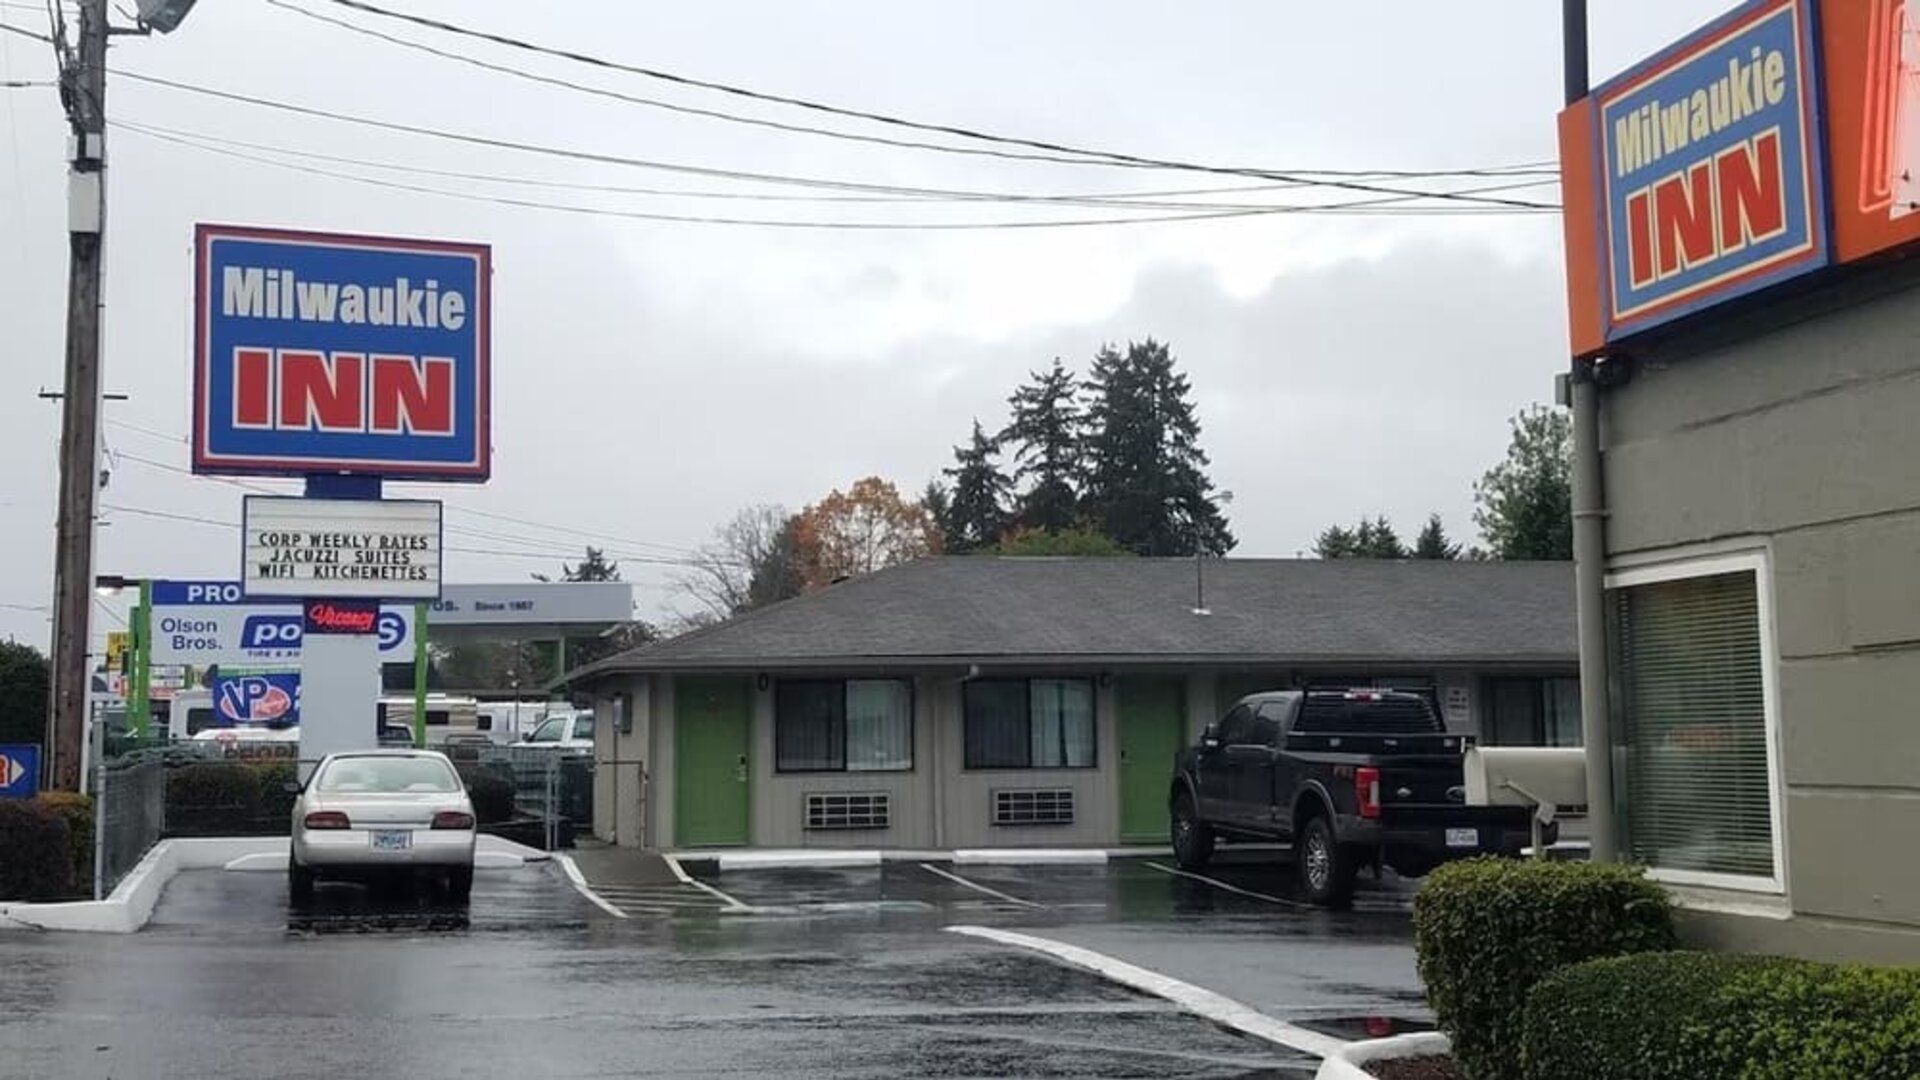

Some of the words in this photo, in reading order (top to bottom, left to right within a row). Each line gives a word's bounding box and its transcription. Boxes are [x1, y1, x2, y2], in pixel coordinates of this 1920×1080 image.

[1615, 46, 1785, 178] Milwaukie
[1626, 126, 1787, 291] INN
[222, 266, 466, 331] Milwaukie
[232, 345, 456, 437] INN
[259, 532, 301, 548] CORP
[309, 533, 372, 549] WEEKLY
[379, 535, 429, 550] RATES
[270, 549, 339, 564] JACUZZI
[354, 551, 411, 565] SUITES
[259, 564, 295, 579] WIFI
[314, 565, 428, 581] KITCHENETTES
[187, 584, 241, 603] PRO
[160, 617, 218, 634] Olson
[308, 603, 377, 632] Vacancy
[172, 634, 223, 650] Bros.
[221, 676, 269, 721] VP
